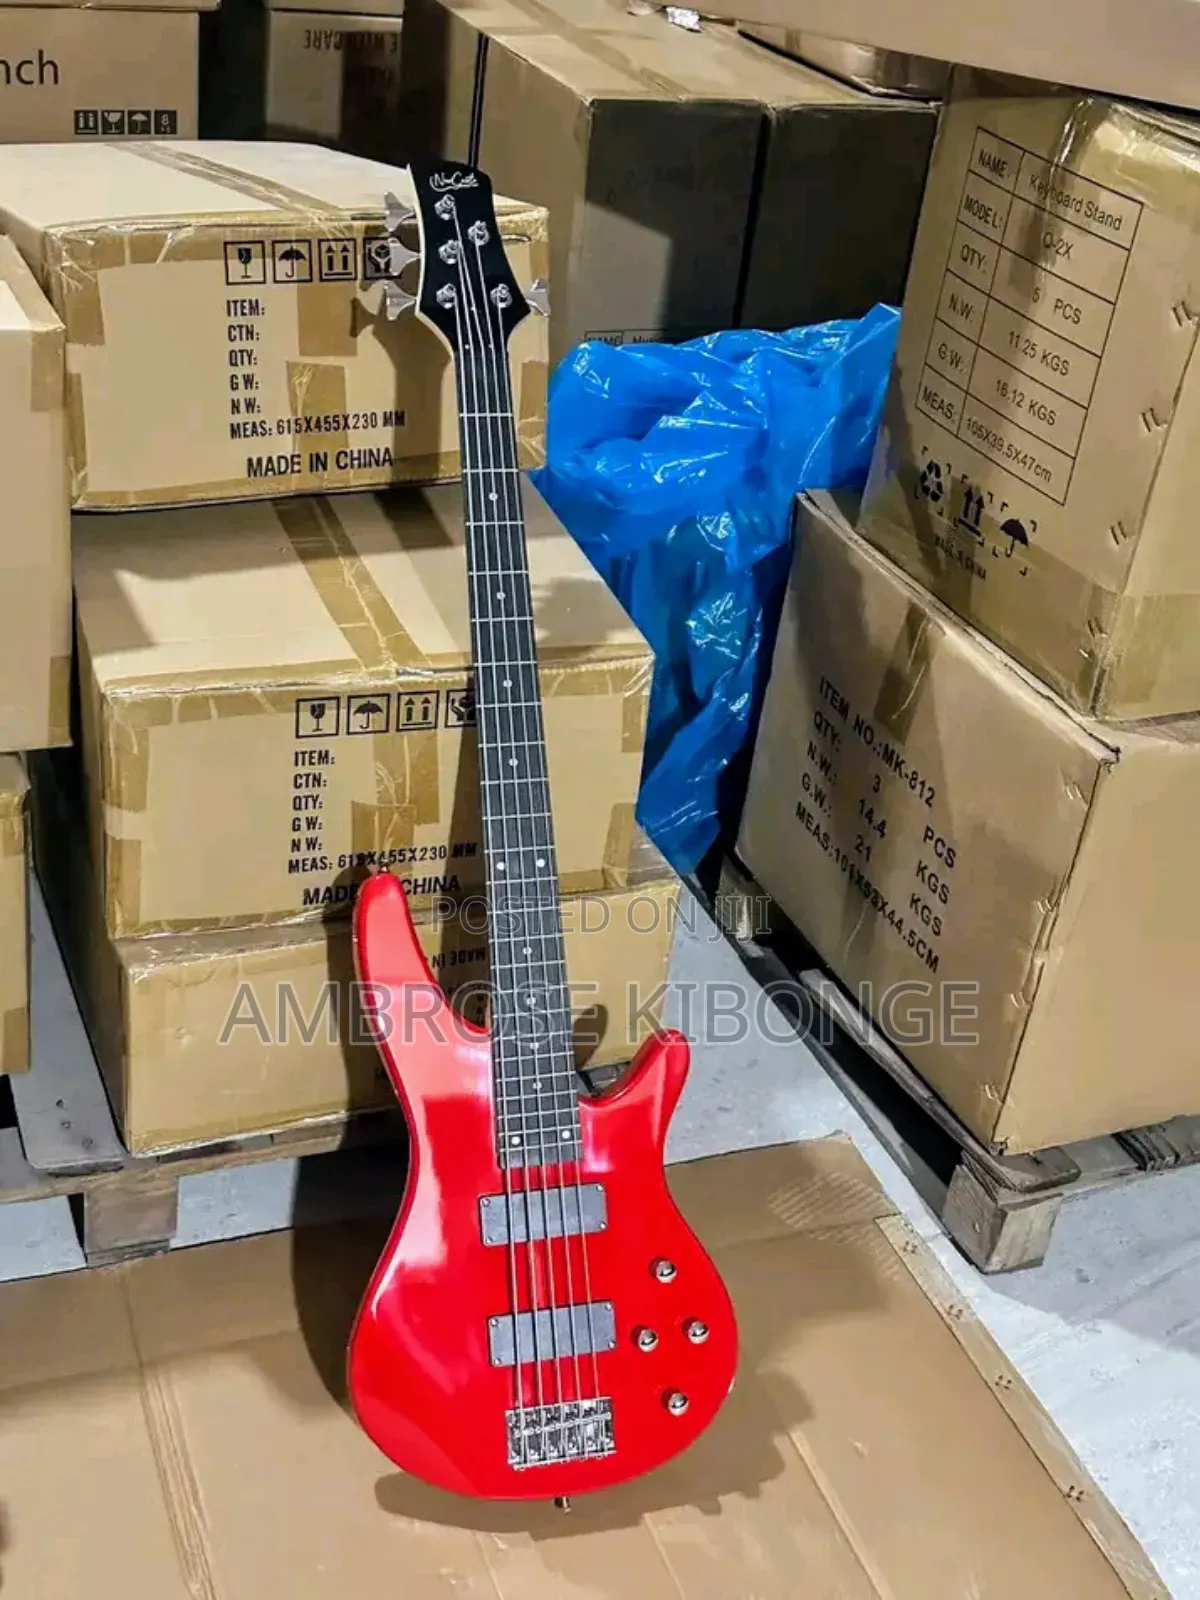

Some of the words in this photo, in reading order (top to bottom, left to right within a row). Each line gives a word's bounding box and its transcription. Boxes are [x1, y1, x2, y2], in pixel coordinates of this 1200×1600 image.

[303, 29, 342, 50] CARE
[0, 49, 59, 85] nch
[963, 195, 1003, 228] MODEL:
[1042, 231, 1073, 260] Q-2X
[1084, 201, 1122, 231] Stand
[960, 244, 987, 273] QTY:
[1032, 287, 1040, 303] 5
[1053, 298, 1082, 325] PCS
[227, 299, 265, 317] ITEM:
[228, 324, 260, 341] CTN:
[229, 349, 257, 366] QTY:
[1041, 349, 1070, 376] KGS
[996, 379, 1024, 409] 16.12
[1028, 399, 1057, 426] KGS
[230, 420, 273, 440] MEAS:
[277, 411, 377, 434] 615X455X230
[383, 410, 405, 427] MM
[247, 454, 301, 478] MADE
[309, 452, 328, 473] IN
[336, 447, 394, 470] CHINA
[820, 675, 850, 724] ITEM
[294, 750, 335, 767] ITEM:
[293, 772, 327, 789] CTN:
[813, 710, 841, 752] QTY:
[872, 774, 882, 793] 3
[923, 825, 957, 869] PCS
[293, 794, 323, 811] QTY:
[288, 856, 333, 874] MEAS:
[452, 842, 477, 858] MM
[859, 799, 888, 839] 14.4
[915, 859, 950, 905] KGS
[402, 875, 461, 895] CHINA
[854, 834, 871, 862] 21
[909, 892, 943, 937] KGS
